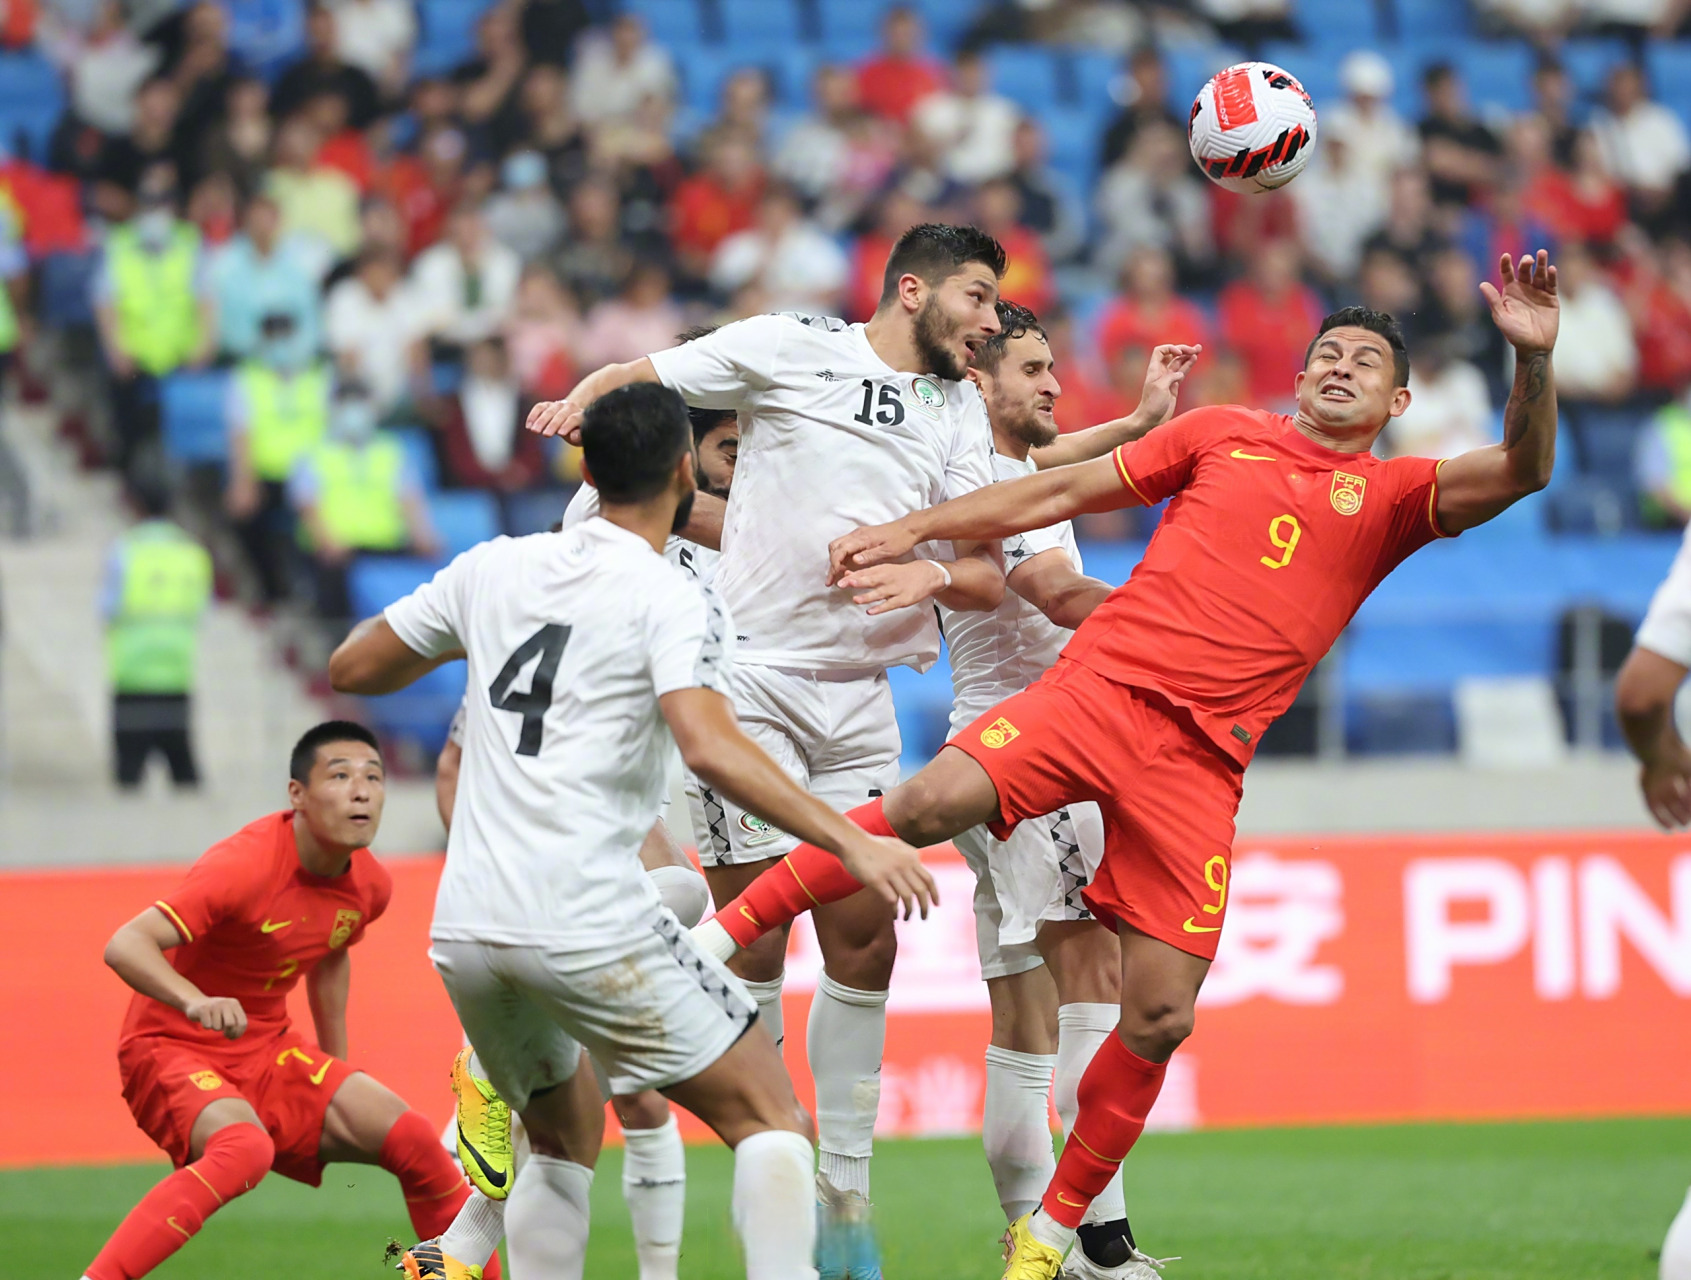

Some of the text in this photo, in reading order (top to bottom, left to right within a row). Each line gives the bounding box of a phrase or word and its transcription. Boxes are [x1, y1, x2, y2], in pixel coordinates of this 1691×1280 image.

[854, 379, 905, 426] 15
[1336, 474, 1363, 487] CFA
[1260, 514, 1302, 569] 9
[489, 623, 572, 757] 4
[1203, 855, 1228, 914] 9
[1404, 854, 1691, 1003] PIN
